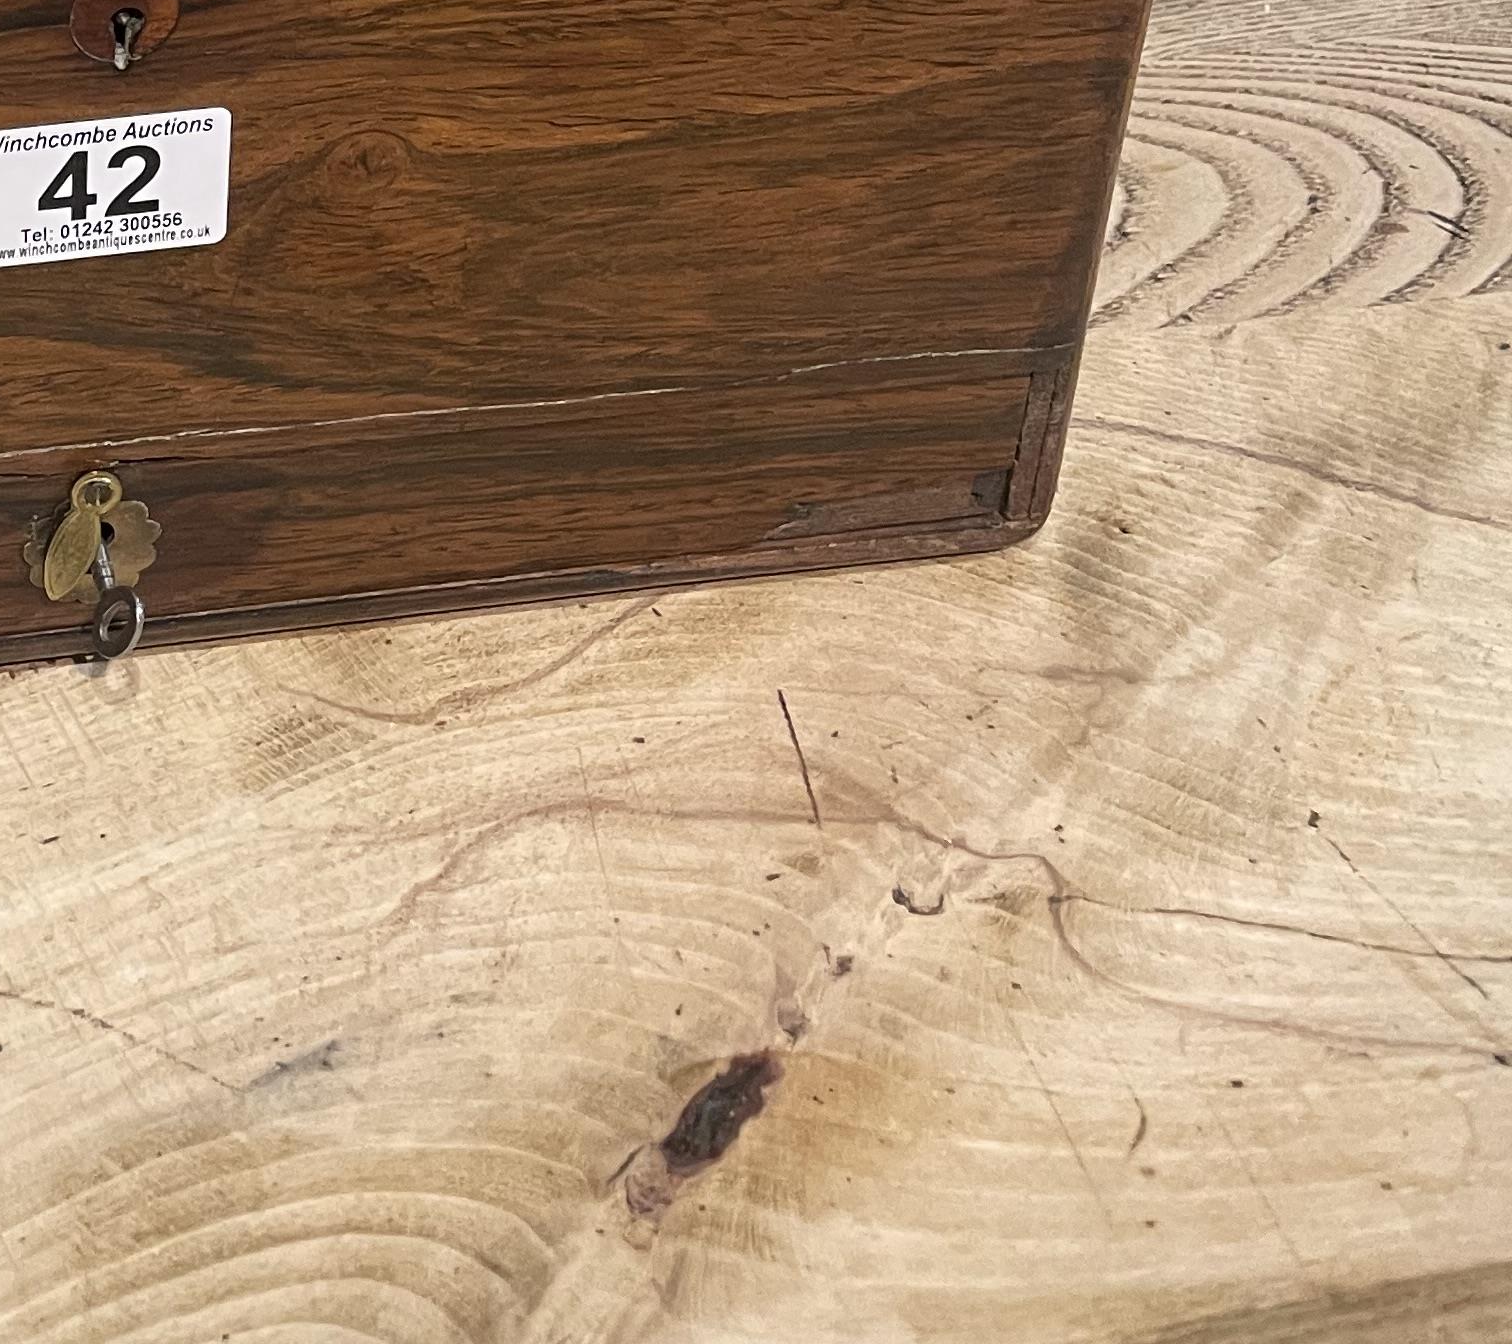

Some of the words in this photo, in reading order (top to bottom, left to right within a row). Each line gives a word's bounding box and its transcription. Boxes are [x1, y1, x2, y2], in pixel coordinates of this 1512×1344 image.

[122, 116, 214, 141] Auctions
[38, 144, 162, 222] 42
[21, 227, 54, 244] Tel:
[60, 219, 114, 240] 01242
[119, 212, 183, 232] 300556
